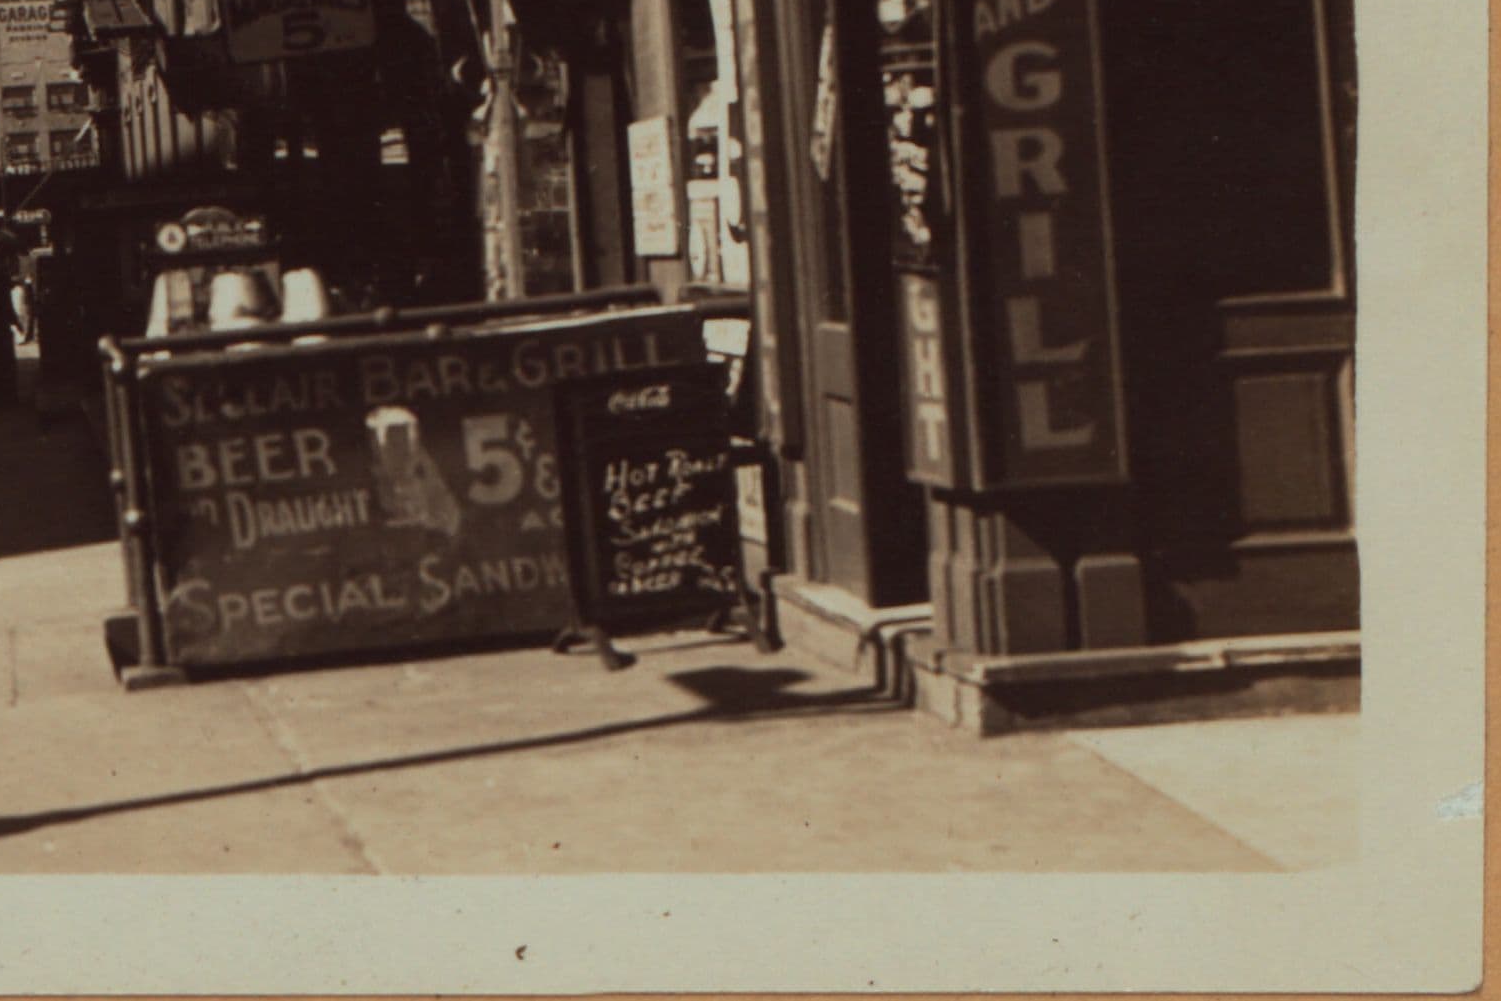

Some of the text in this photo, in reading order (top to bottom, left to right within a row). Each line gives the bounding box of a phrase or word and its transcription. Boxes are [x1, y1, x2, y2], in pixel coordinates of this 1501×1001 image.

[985, 41, 1097, 453] GRILL
[361, 355, 472, 404] BAR
[512, 334, 682, 390] GRILL
[177, 428, 338, 490] BEER
[603, 459, 659, 492] HOT
[226, 488, 370, 549] DRAUGHT
[167, 573, 407, 632] SPECIAL
